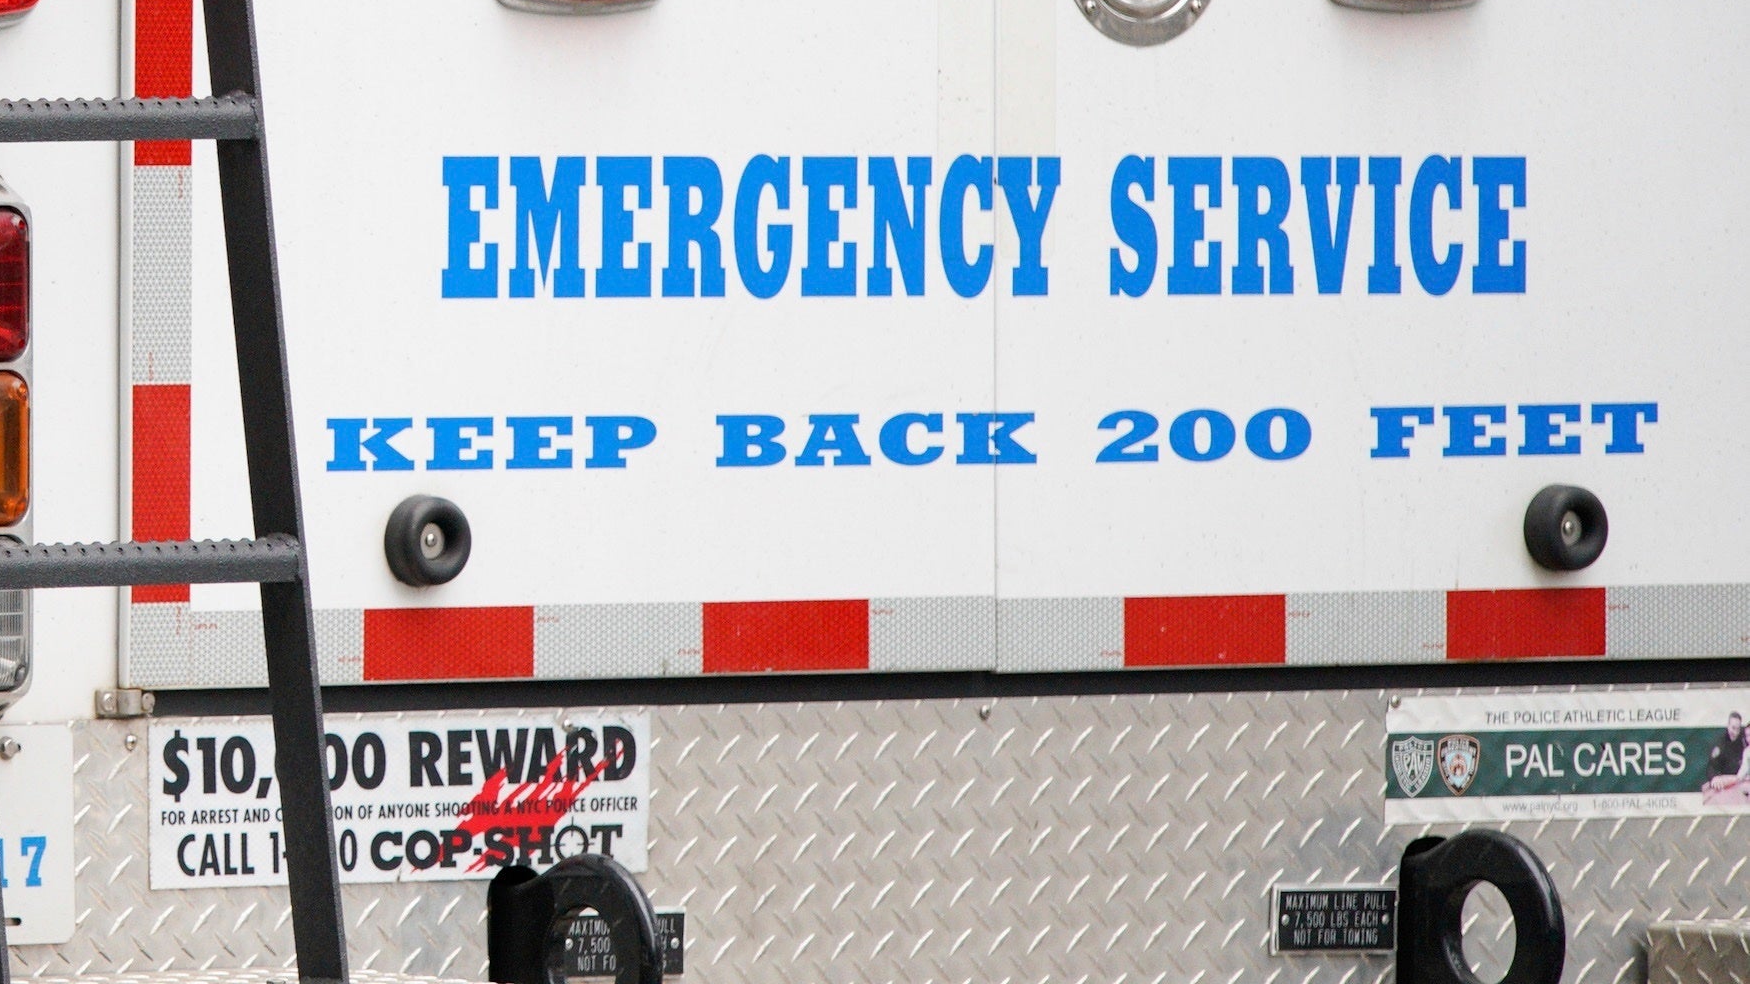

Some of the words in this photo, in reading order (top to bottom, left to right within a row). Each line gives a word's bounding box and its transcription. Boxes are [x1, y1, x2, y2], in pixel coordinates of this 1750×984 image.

[441, 153, 1062, 300] EMERGENCY
[1109, 153, 1527, 299] SERVICE
[326, 415, 658, 472] KEEP
[715, 411, 1037, 468] BACK
[1095, 407, 1312, 464] 200
[1369, 401, 1658, 459] FEET
[1485, 710, 1511, 724] THE
[1513, 709, 1561, 724] POLICE
[1563, 708, 1626, 723] ATHLETIC
[1628, 707, 1681, 722] LEAGUE
[162, 729, 387, 802] $10,00
[408, 725, 637, 788] REWARD
[1505, 743, 1565, 778] PAL
[1573, 740, 1687, 778] CARES
[161, 810, 186, 825] FOR
[191, 808, 239, 825] ARREST
[243, 807, 271, 823] AND
[357, 804, 373, 820] OF
[378, 803, 431, 818] ANYONE
[435, 800, 499, 817] SHOOTING
[503, 800, 513, 814] A
[517, 799, 543, 814] NYC
[545, 797, 586, 814] POLICE
[590, 796, 638, 812] OFFICER
[176, 831, 255, 877] CALL
[370, 822, 624, 872] COP-SHOT
[1285, 893, 1330, 910] MAXIMUM
[1333, 892, 1358, 910] LINE
[1363, 892, 1388, 909] PULL
[1294, 911, 1326, 928] 7,500
[1330, 911, 1349, 928] LBS
[1353, 910, 1379, 927] EACH
[577, 937, 611, 954] 7,500
[1293, 928, 1311, 946] NOT
[1317, 928, 1337, 945] FOR
[1343, 928, 1379, 945] TOWING
[577, 955, 596, 972] NOT
[603, 955, 617, 972] FO
